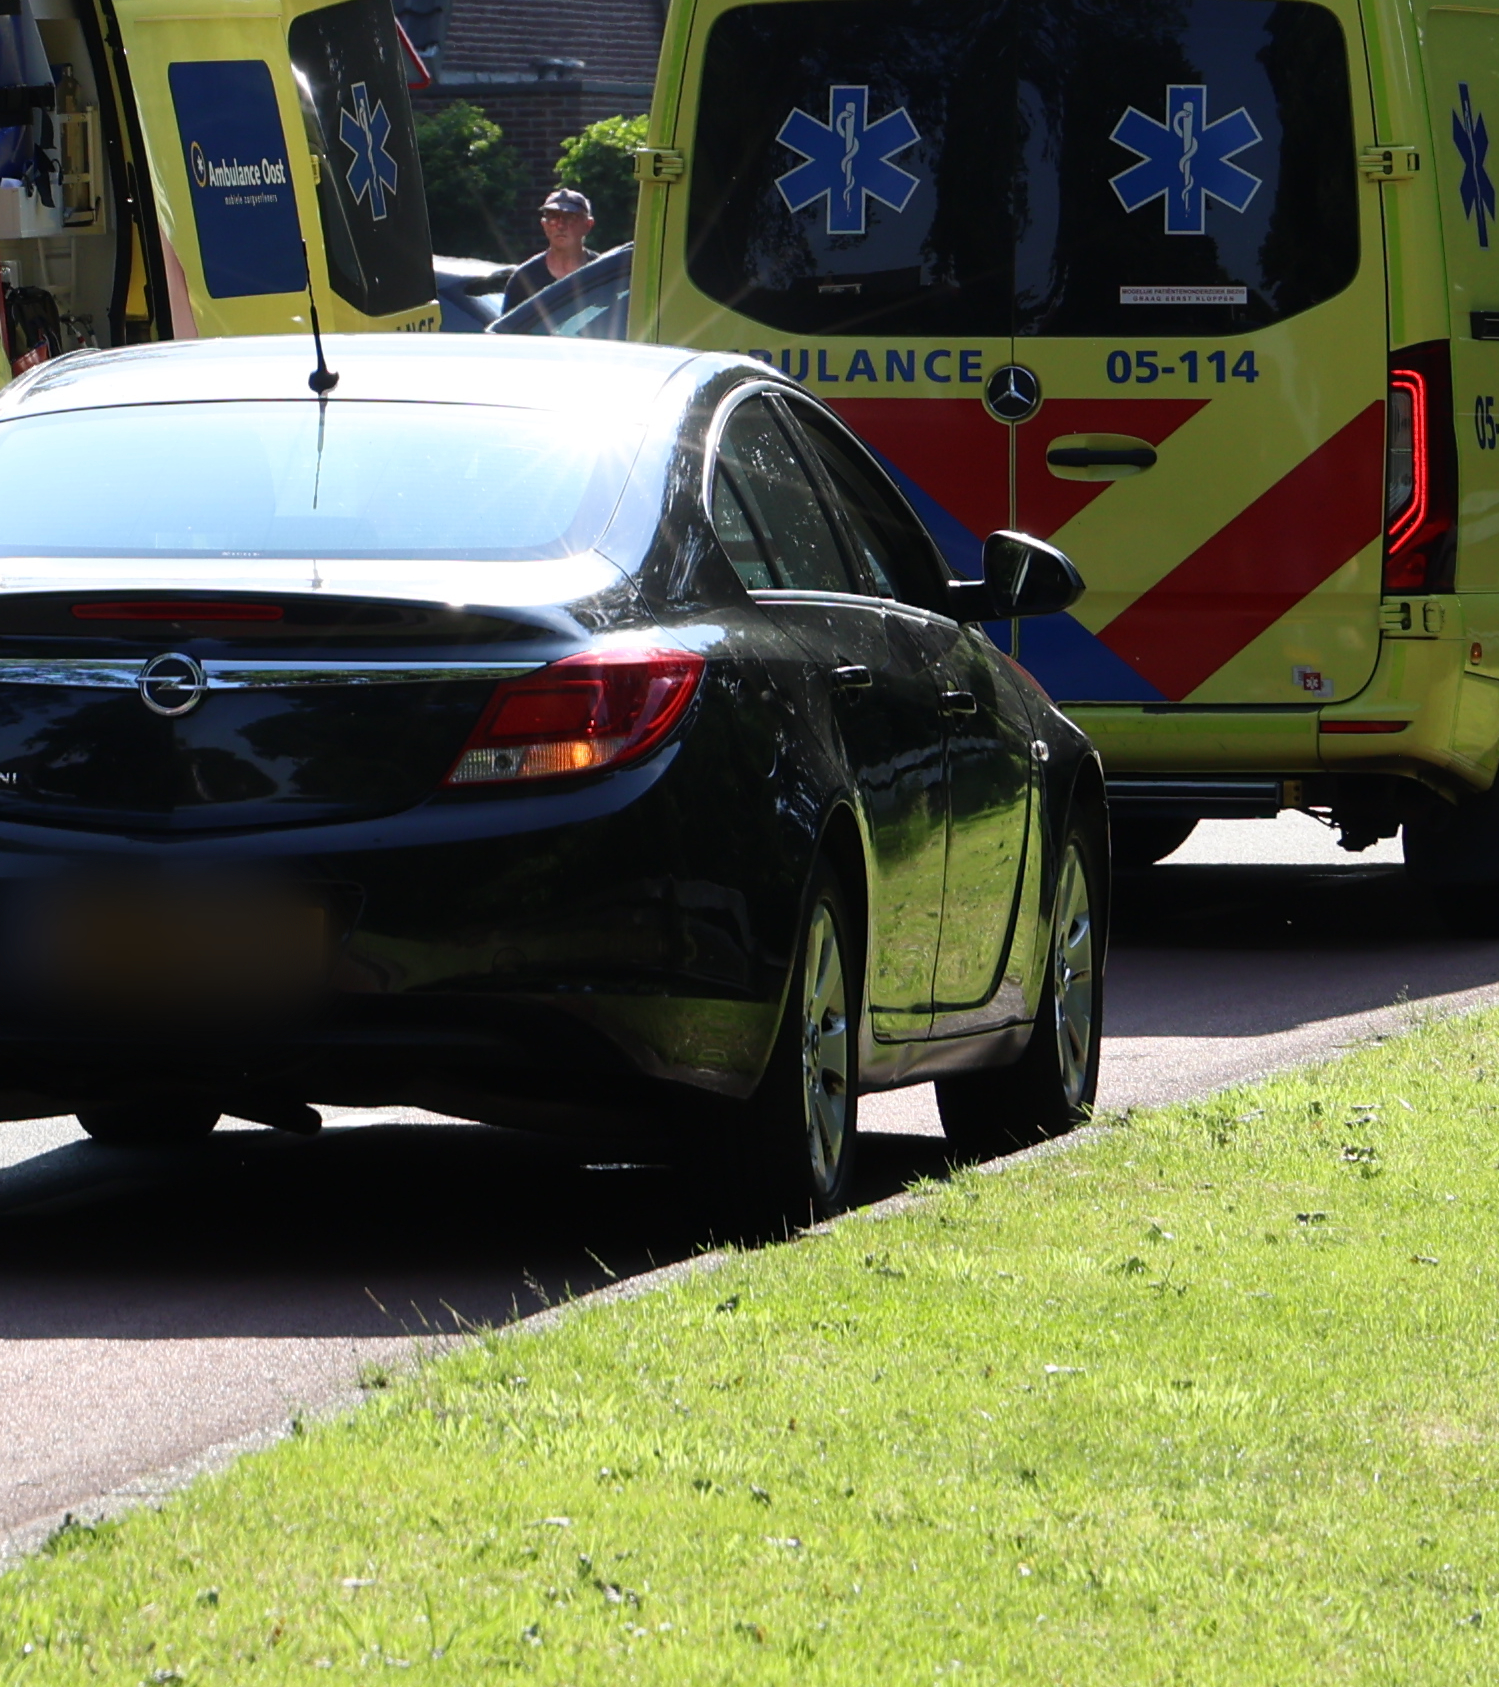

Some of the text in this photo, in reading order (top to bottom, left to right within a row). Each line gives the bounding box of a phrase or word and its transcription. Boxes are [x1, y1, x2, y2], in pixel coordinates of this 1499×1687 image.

[208, 157, 287, 188] Ambulance Oost
[1106, 350, 1259, 384] 05-114
